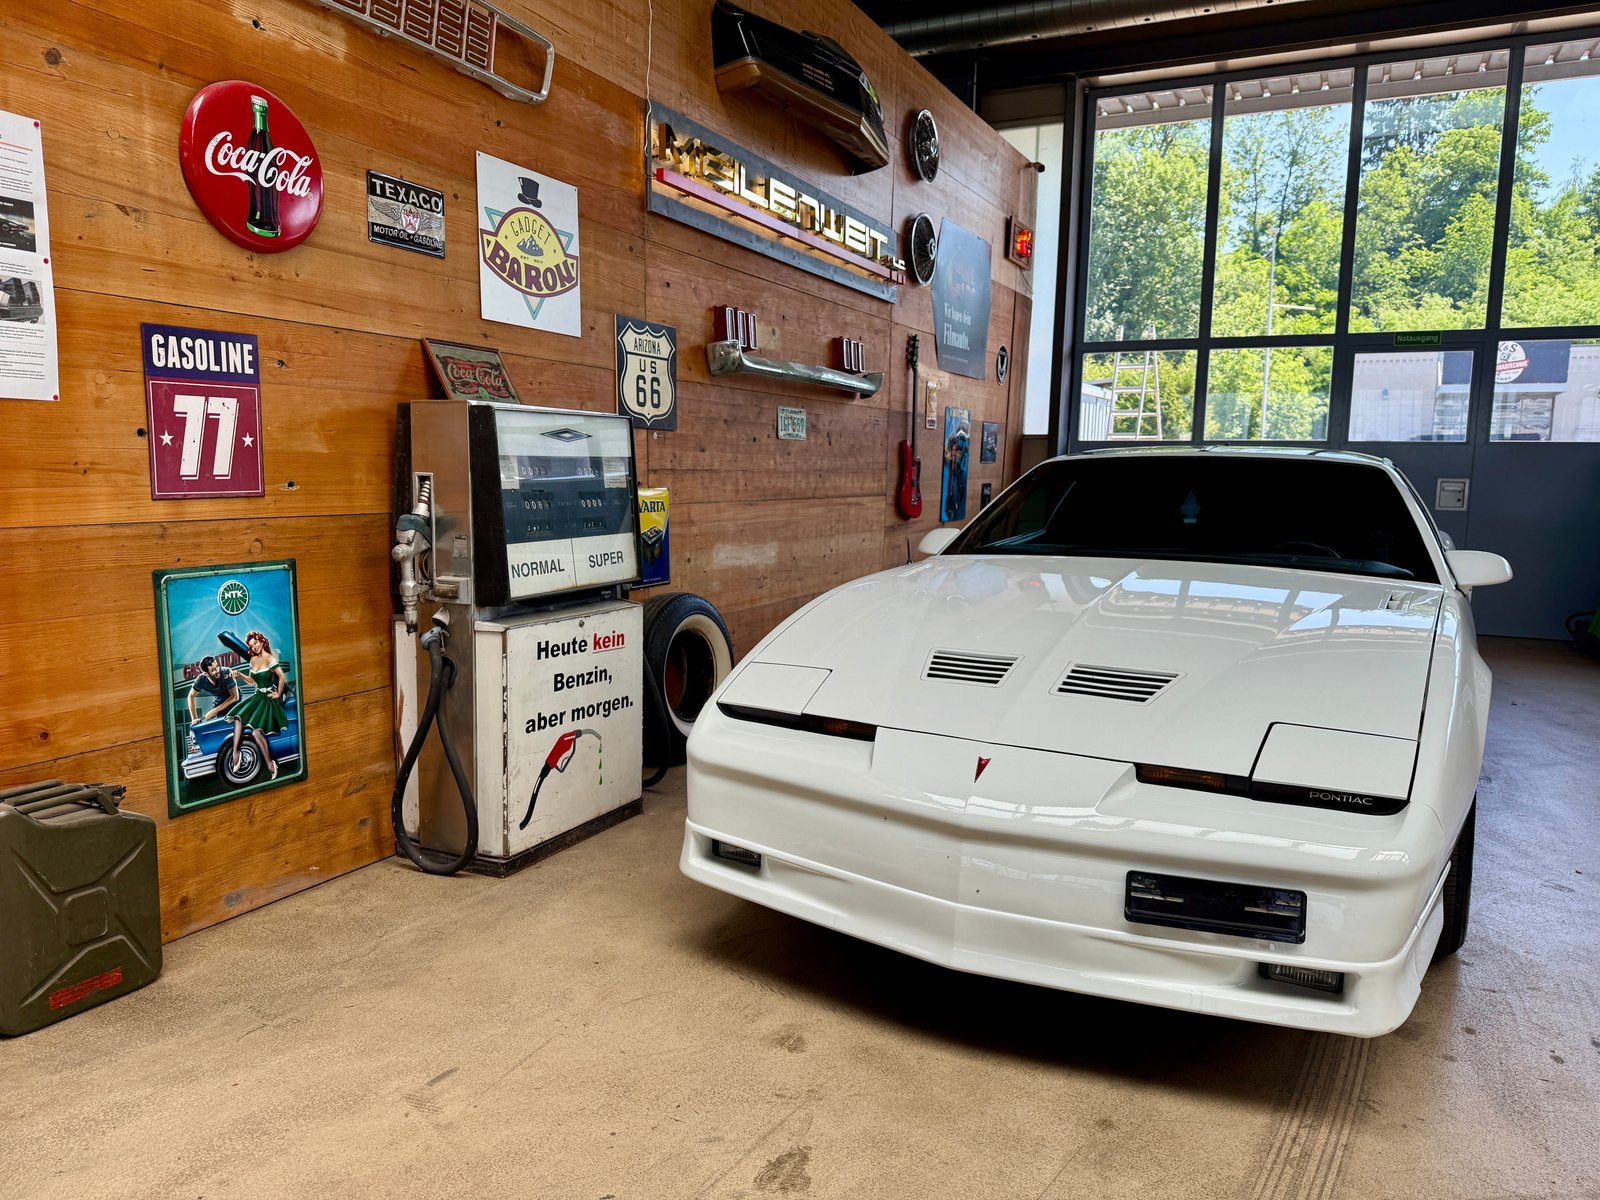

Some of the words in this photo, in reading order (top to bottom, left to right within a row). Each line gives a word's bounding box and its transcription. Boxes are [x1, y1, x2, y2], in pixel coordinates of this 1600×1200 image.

[204, 131, 313, 198] Coca-Cola
[371, 178, 441, 212] TEXACO
[373, 225, 398, 238] MOTOR
[399, 231, 410, 241] OIL
[413, 235, 443, 249] GASOLINE
[510, 216, 552, 245] GADGET
[488, 240, 575, 292] BARON
[633, 337, 661, 355] ARIZONA
[1397, 335, 1439, 343] Notausgang
[151, 333, 255, 375] GASOLINE
[447, 363, 504, 387] Coca-Cola
[636, 374, 661, 409] 66
[639, 499, 666, 514] VARTA
[511, 558, 565, 579] NORMAL
[588, 550, 624, 569] SUPER
[224, 589, 243, 600] NTK
[536, 636, 588, 661] Heute
[593, 630, 625, 651] kein
[553, 665, 612, 692] Benzin,
[525, 710, 566, 734] aber
[571, 694, 634, 722] morgen.
[1309, 790, 1373, 806] PONTIAC
